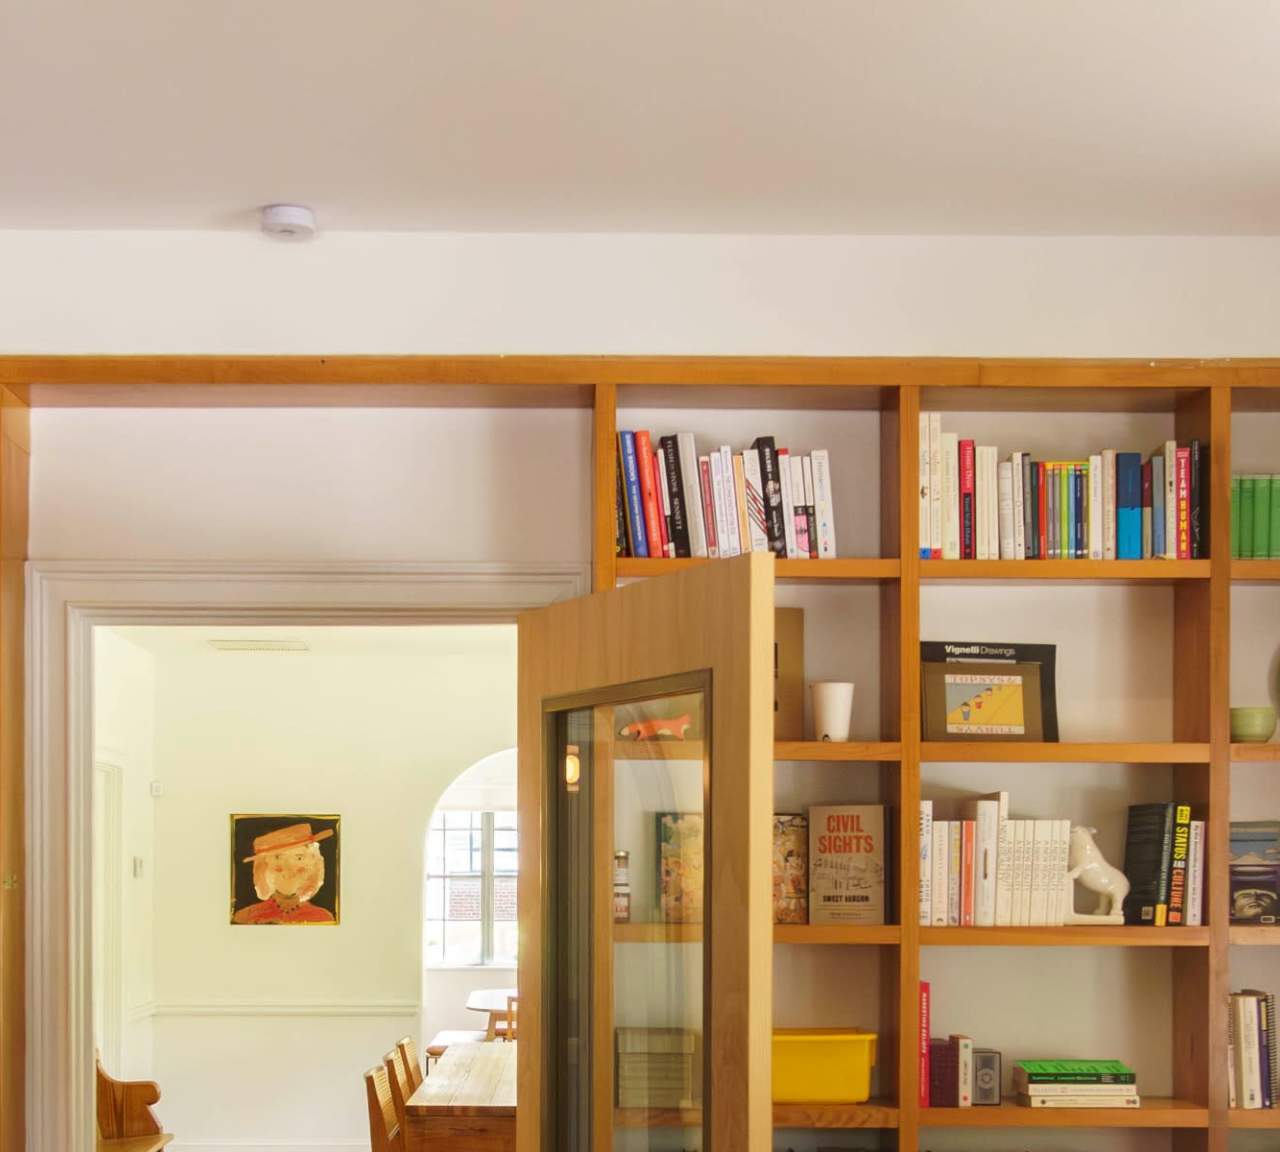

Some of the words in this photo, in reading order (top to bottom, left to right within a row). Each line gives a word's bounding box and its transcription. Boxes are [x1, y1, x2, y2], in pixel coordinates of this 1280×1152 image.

[1178, 457, 1188, 499] TEAM
[1178, 500, 1188, 552] HUMAN
[945, 644, 980, 655] Vignelli
[980, 646, 1016, 656] Drawings
[826, 814, 864, 833] CIVIL
[817, 836, 875, 855] SIGHTS
[1174, 826, 1189, 860] STATUS
[822, 895, 843, 903] SWEET
[1170, 869, 1185, 910] CULTURE
